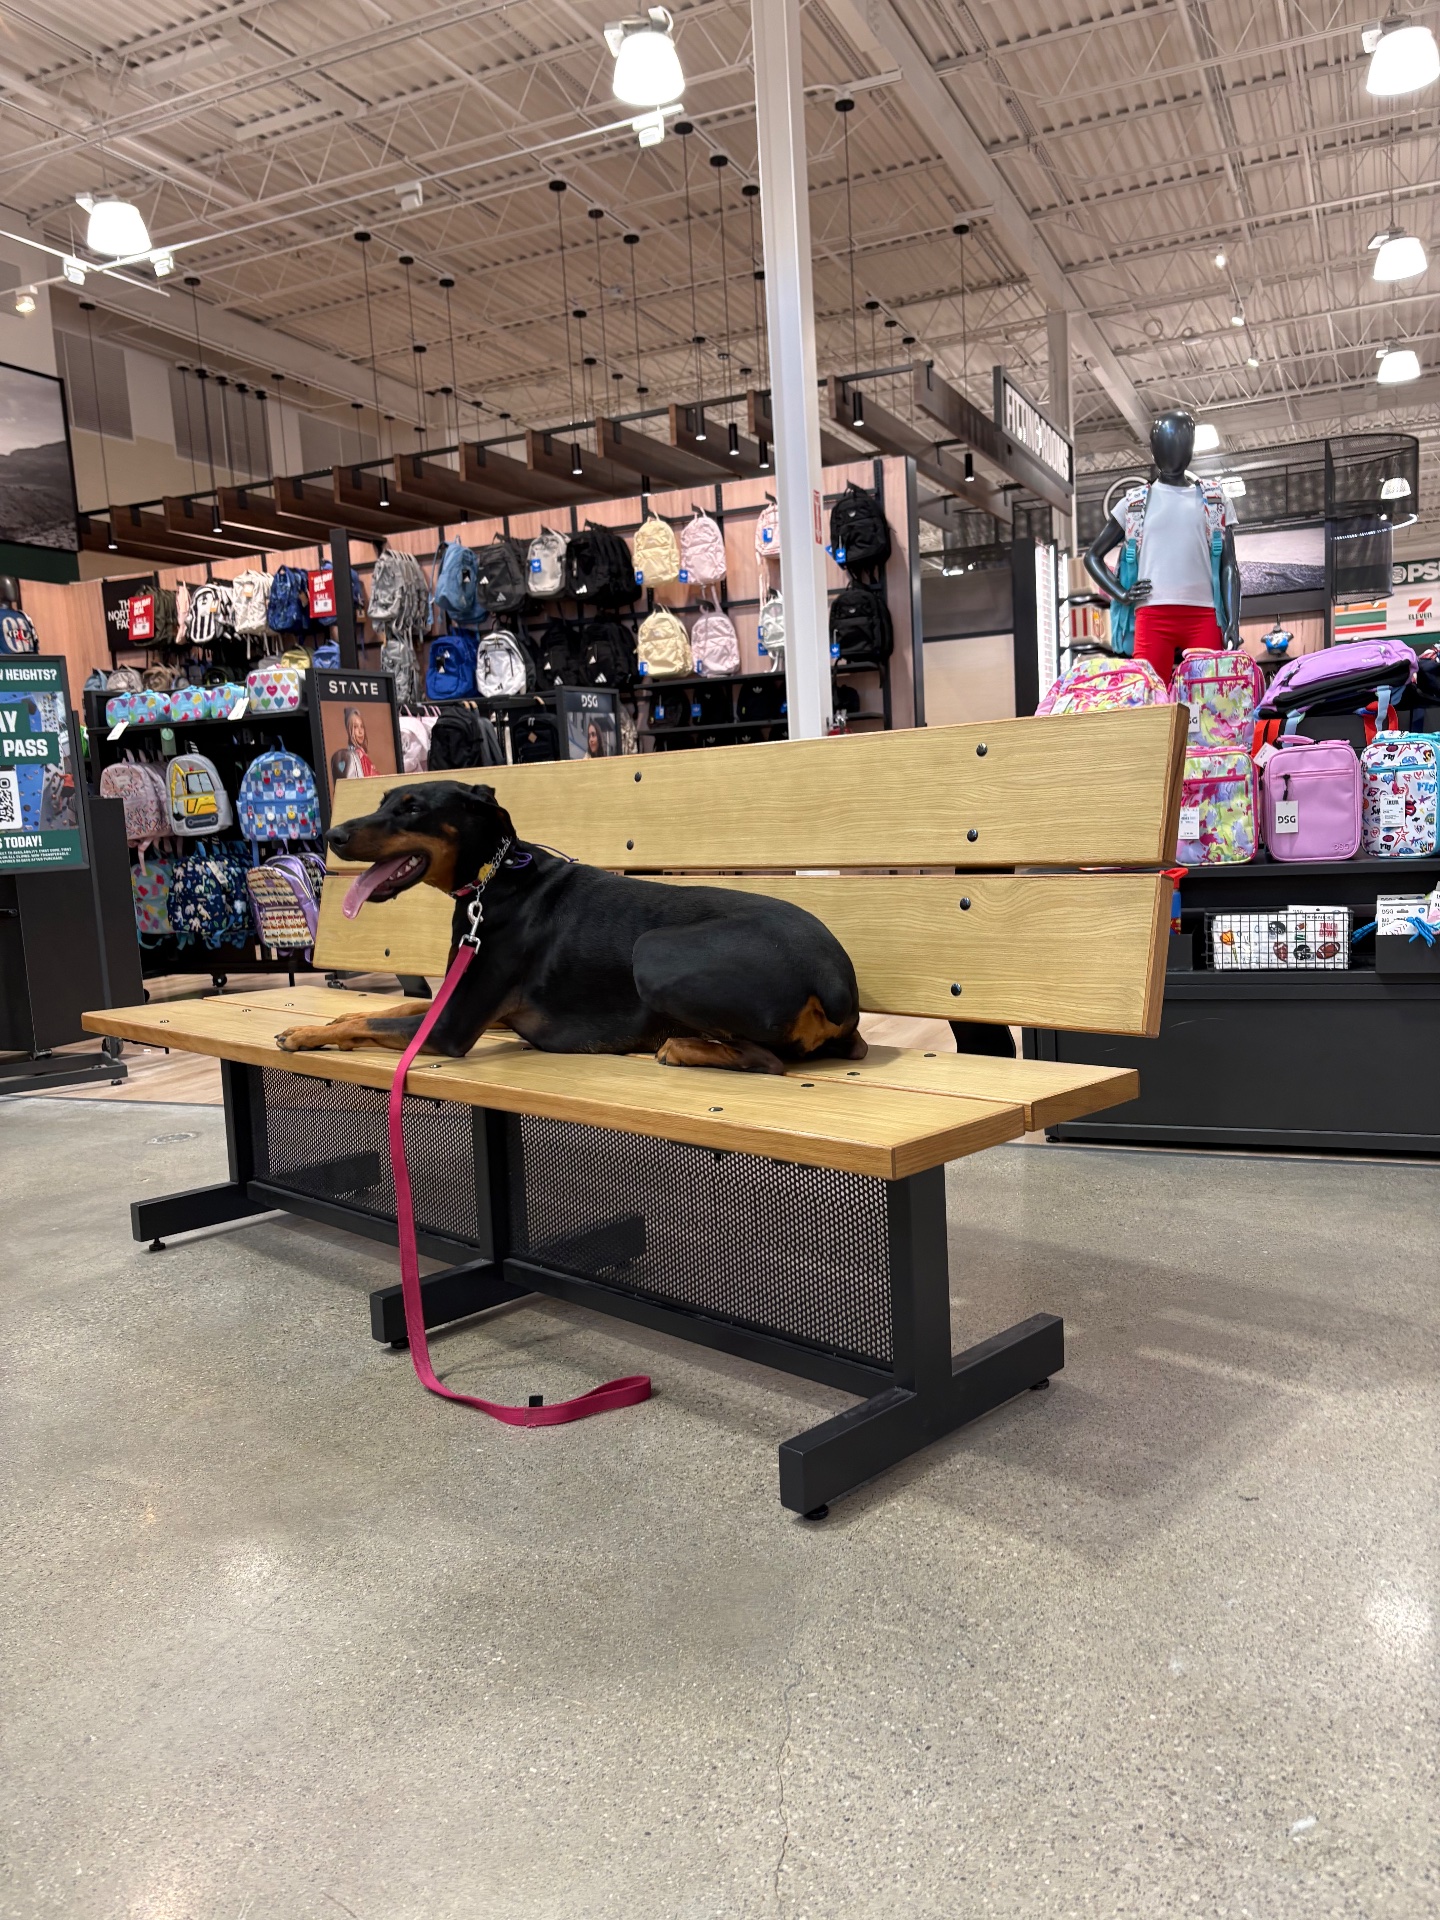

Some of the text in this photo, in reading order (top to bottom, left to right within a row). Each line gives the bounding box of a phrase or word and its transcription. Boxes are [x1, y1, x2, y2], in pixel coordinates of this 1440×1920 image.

[1041, 417, 1070, 482] ROOMS
[1408, 561, 1440, 583] PS
[118, 600, 130, 608] TH
[107, 609, 130, 622] NORT
[5, 668, 58, 681] HEIGHTS?
[328, 680, 379, 696] STATE
[581, 694, 599, 708] DSG
[3, 738, 49, 757] PASS
[1277, 815, 1297, 824] DSG
[3, 835, 43, 849] TODAY!
